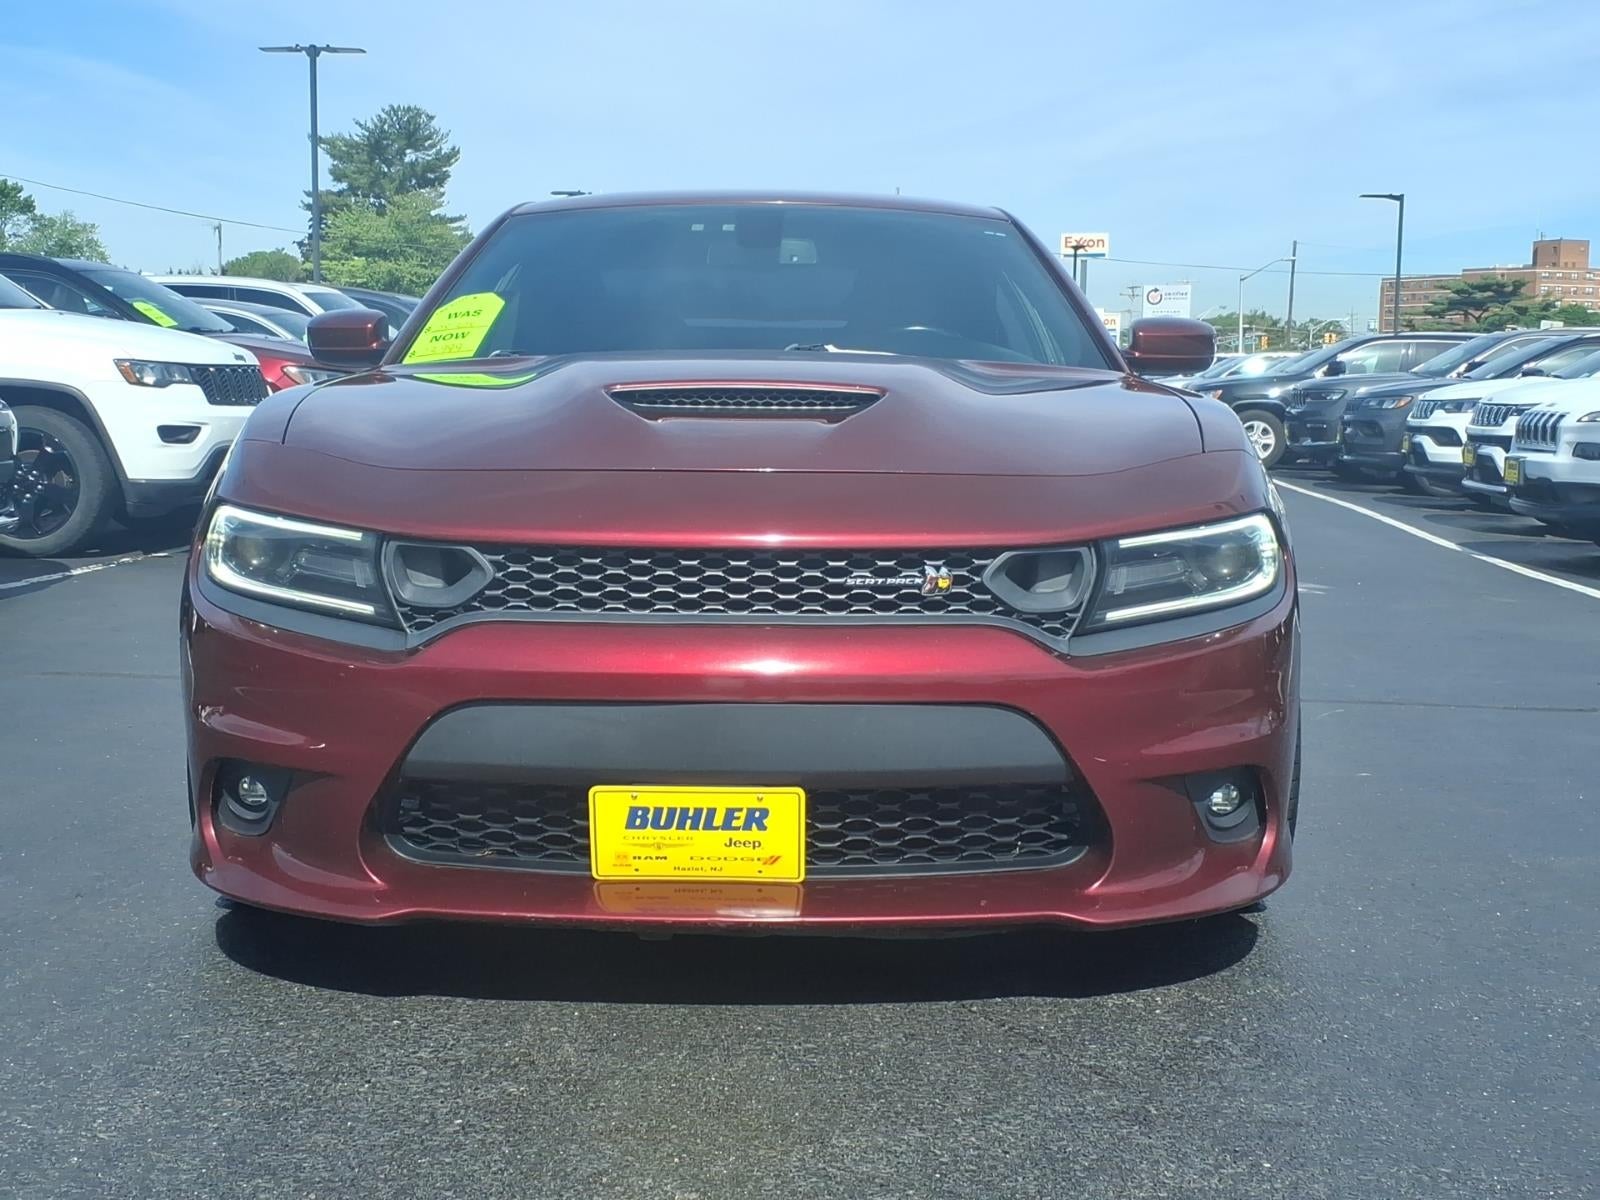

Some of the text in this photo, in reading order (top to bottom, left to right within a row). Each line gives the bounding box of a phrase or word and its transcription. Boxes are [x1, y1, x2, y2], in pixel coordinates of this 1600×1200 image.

[1064, 236, 1105, 252] Exxon
[447, 309, 483, 320] WAS
[430, 331, 470, 343] NOW
[625, 806, 770, 831] BUHLER
[724, 837, 762, 850] Jeep
